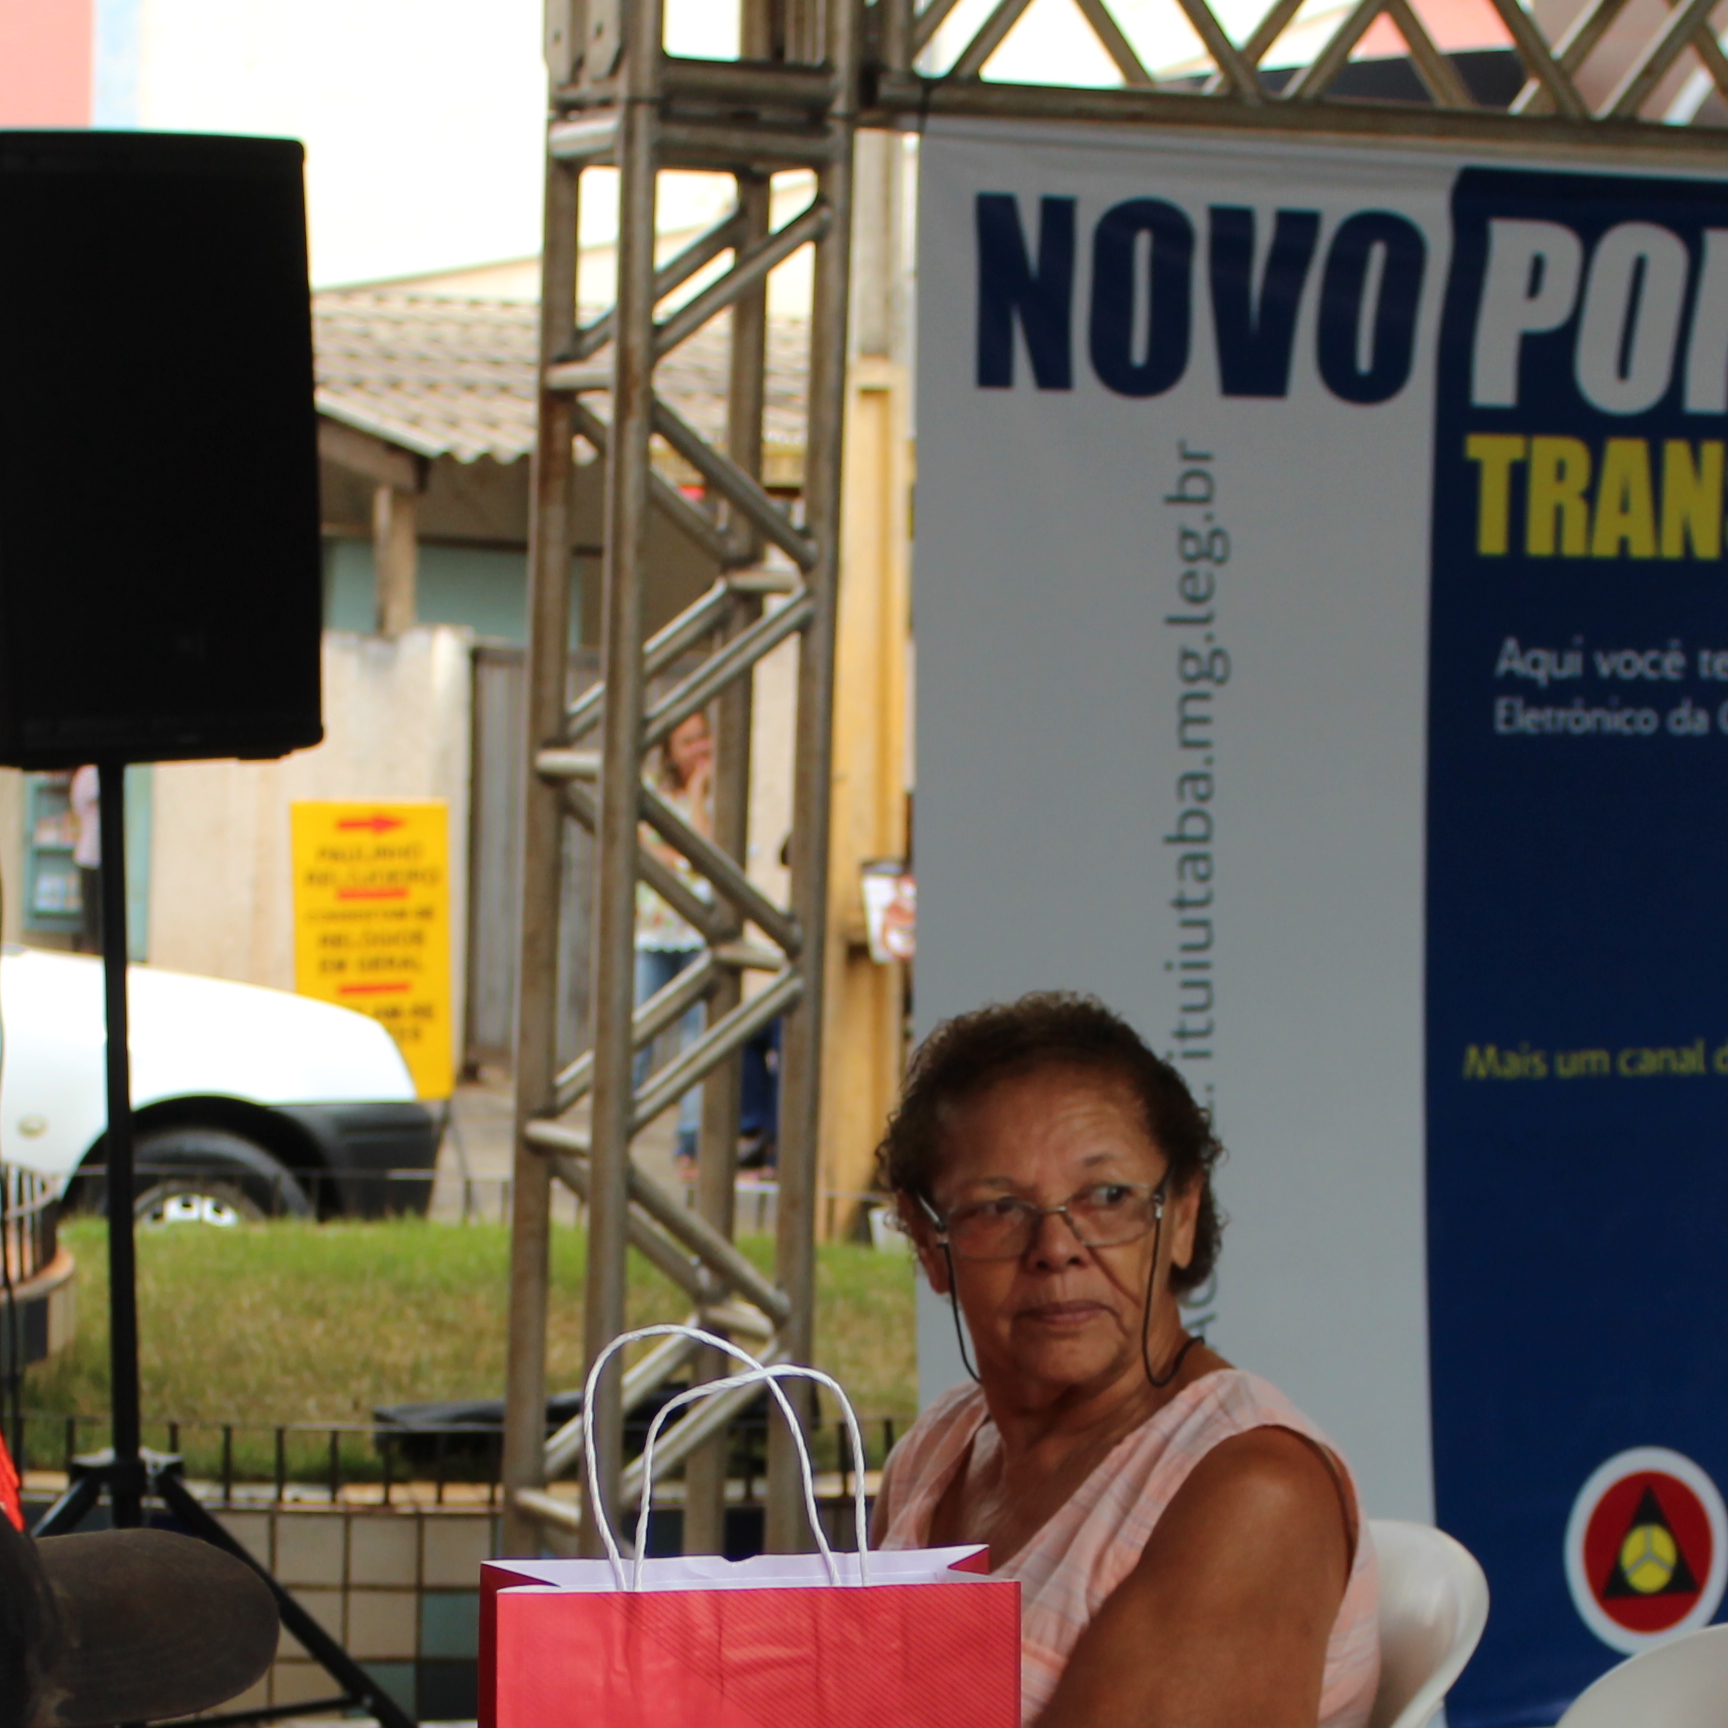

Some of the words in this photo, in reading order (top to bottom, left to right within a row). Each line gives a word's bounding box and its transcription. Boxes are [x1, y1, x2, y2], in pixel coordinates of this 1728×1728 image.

[974, 193, 1428, 405] NOVO
[1496, 637, 1584, 687] Aqui
[1595, 640, 1685, 682] você
[1494, 697, 1658, 737] Eletrônico
[1667, 699, 1710, 737] da
[1464, 1044, 1547, 1080] Mais
[1556, 1050, 1610, 1078] um
[1618, 1041, 1706, 1078] canal
